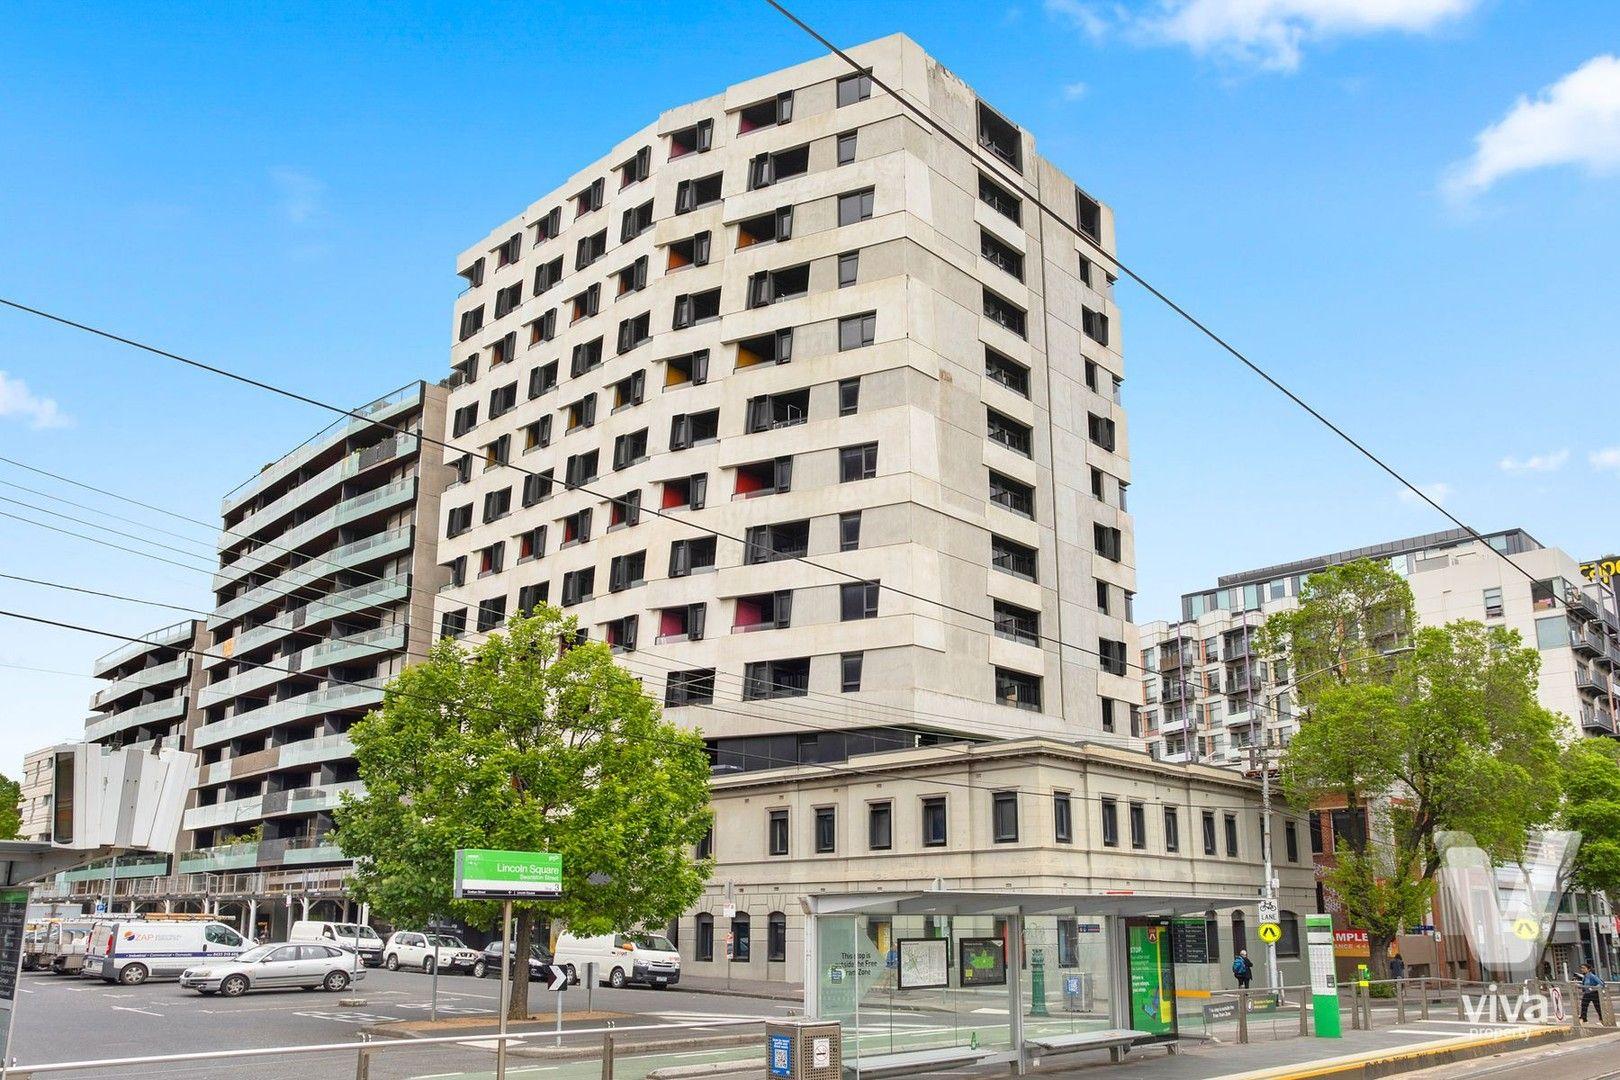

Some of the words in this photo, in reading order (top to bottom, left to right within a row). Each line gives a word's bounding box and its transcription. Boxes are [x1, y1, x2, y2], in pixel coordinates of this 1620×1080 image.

[497, 863, 528, 873] Lincoln
[529, 864, 559, 875] Square
[1333, 932, 1368, 942] MPLE
[858, 968, 871, 976] Zone
